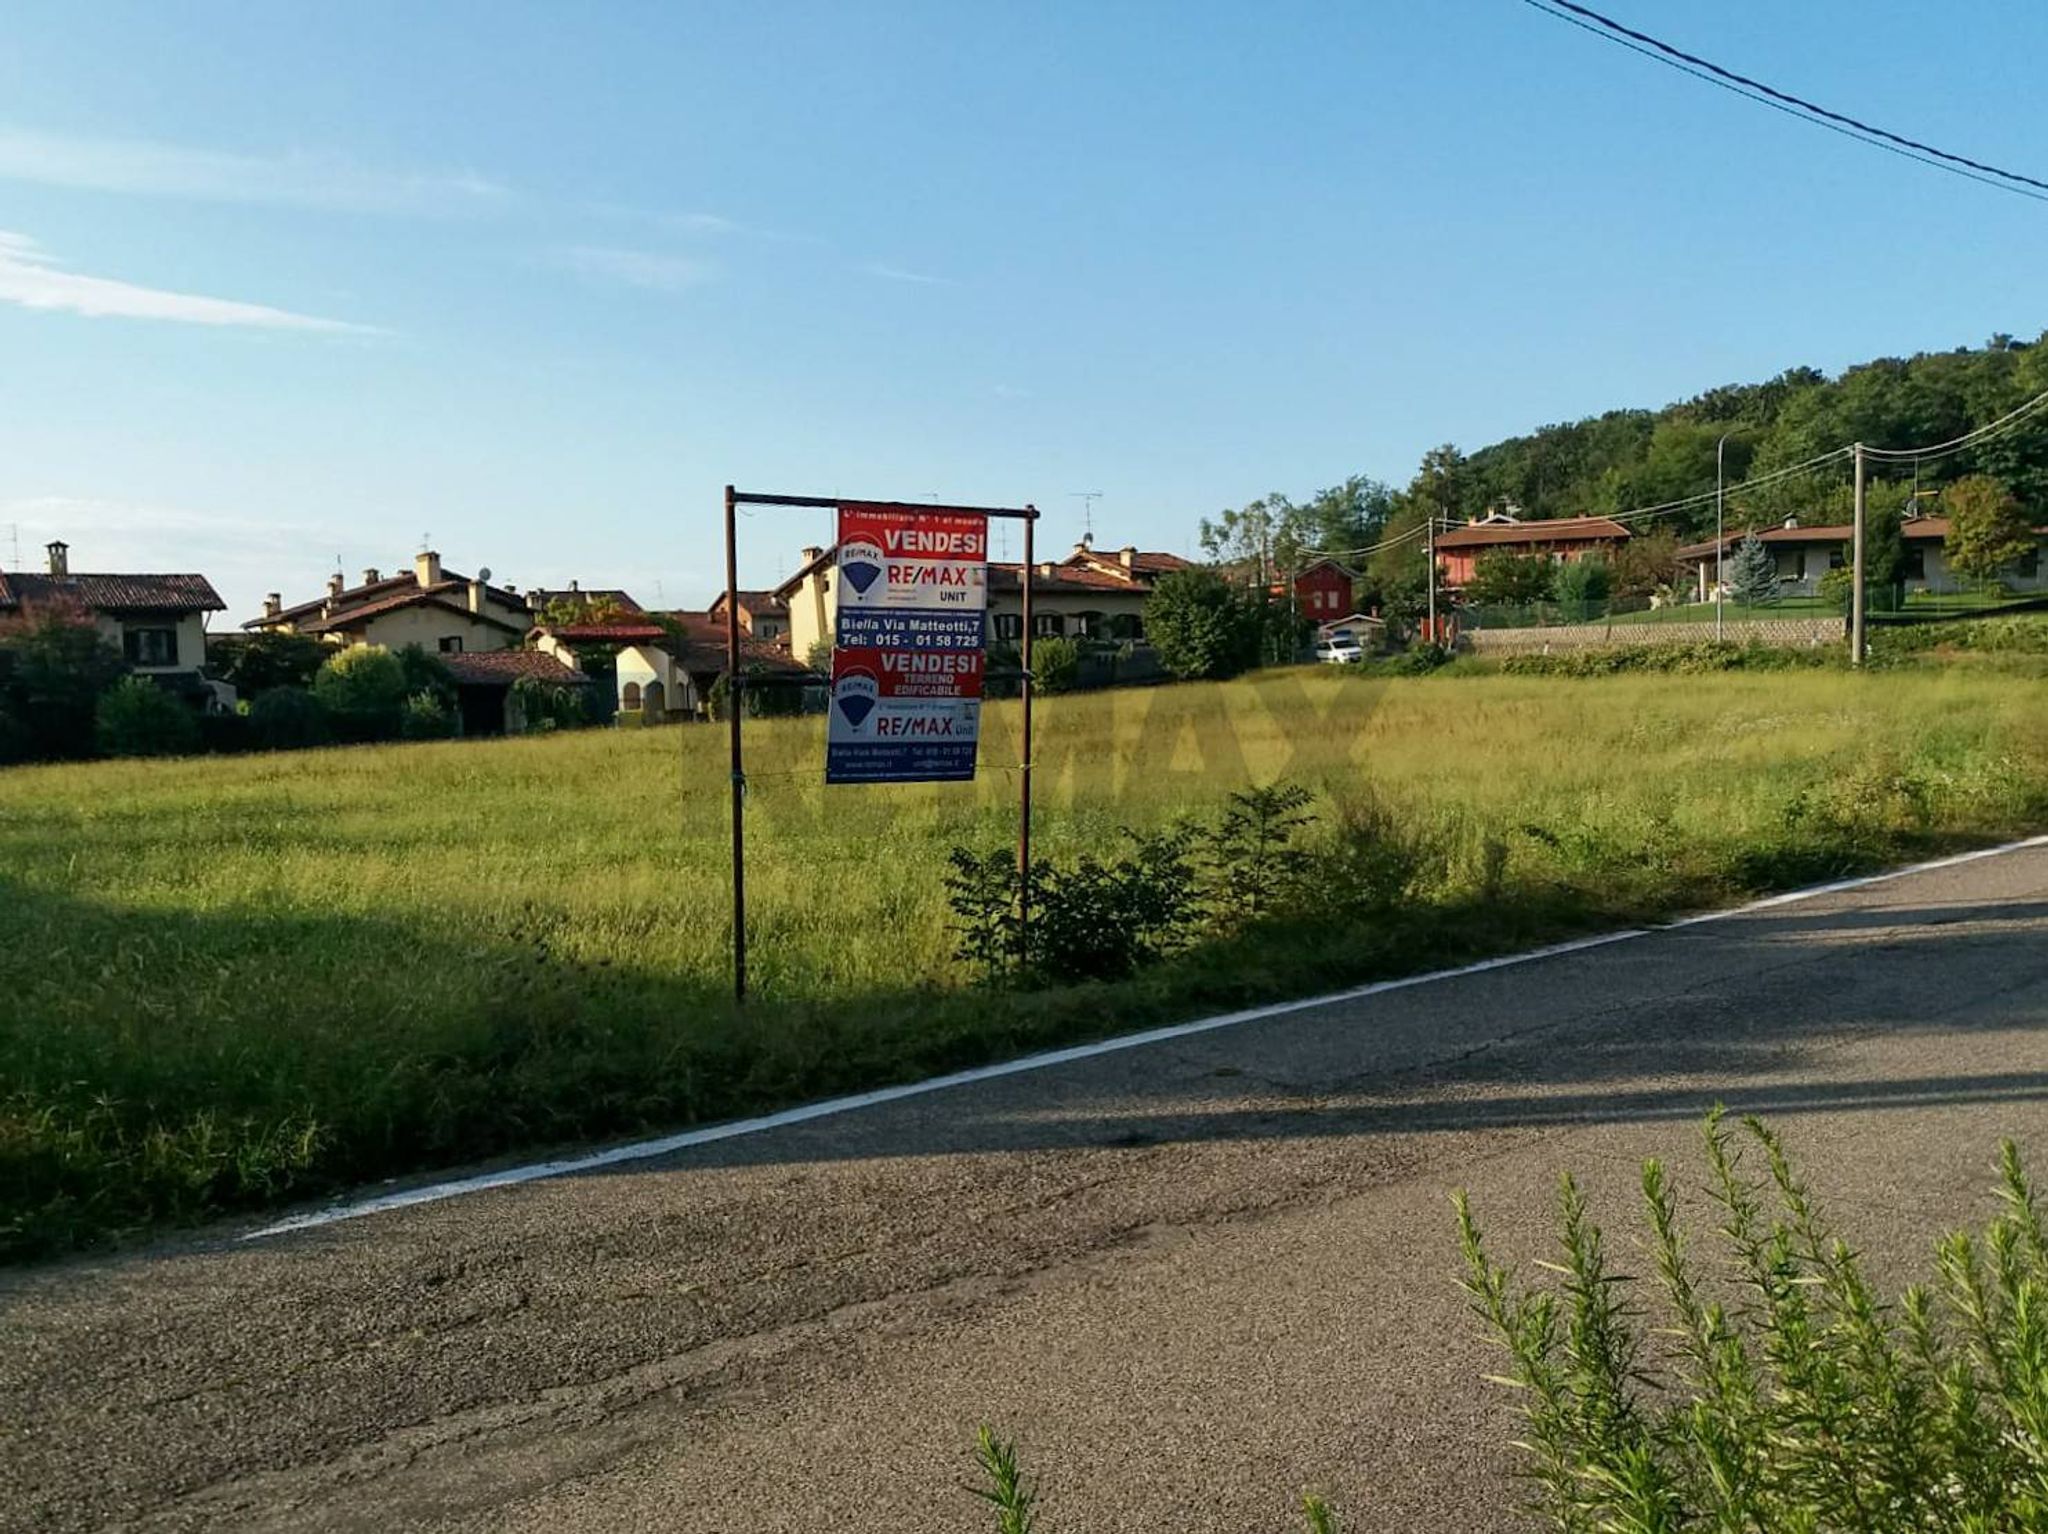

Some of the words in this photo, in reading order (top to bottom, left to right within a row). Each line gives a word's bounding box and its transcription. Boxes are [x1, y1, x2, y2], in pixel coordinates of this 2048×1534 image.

[884, 528, 985, 554] VENDESI
[844, 547, 879, 561] RE/MAX
[887, 565, 968, 587] RE/MAX
[940, 590, 967, 603] UNIT
[841, 618, 879, 630] Biella
[883, 619, 905, 630] Via
[909, 619, 980, 634] Matteotti,7
[841, 633, 868, 645] Tel:
[875, 634, 900, 645] 015
[916, 635, 933, 646] 01
[936, 635, 952, 646] 58
[955, 635, 979, 646] 725
[881, 653, 977, 673] VENDESI
[903, 673, 955, 685] TERRENO
[894, 685, 962, 696] EDIFICABILE
[877, 717, 953, 737] RE/MAX
